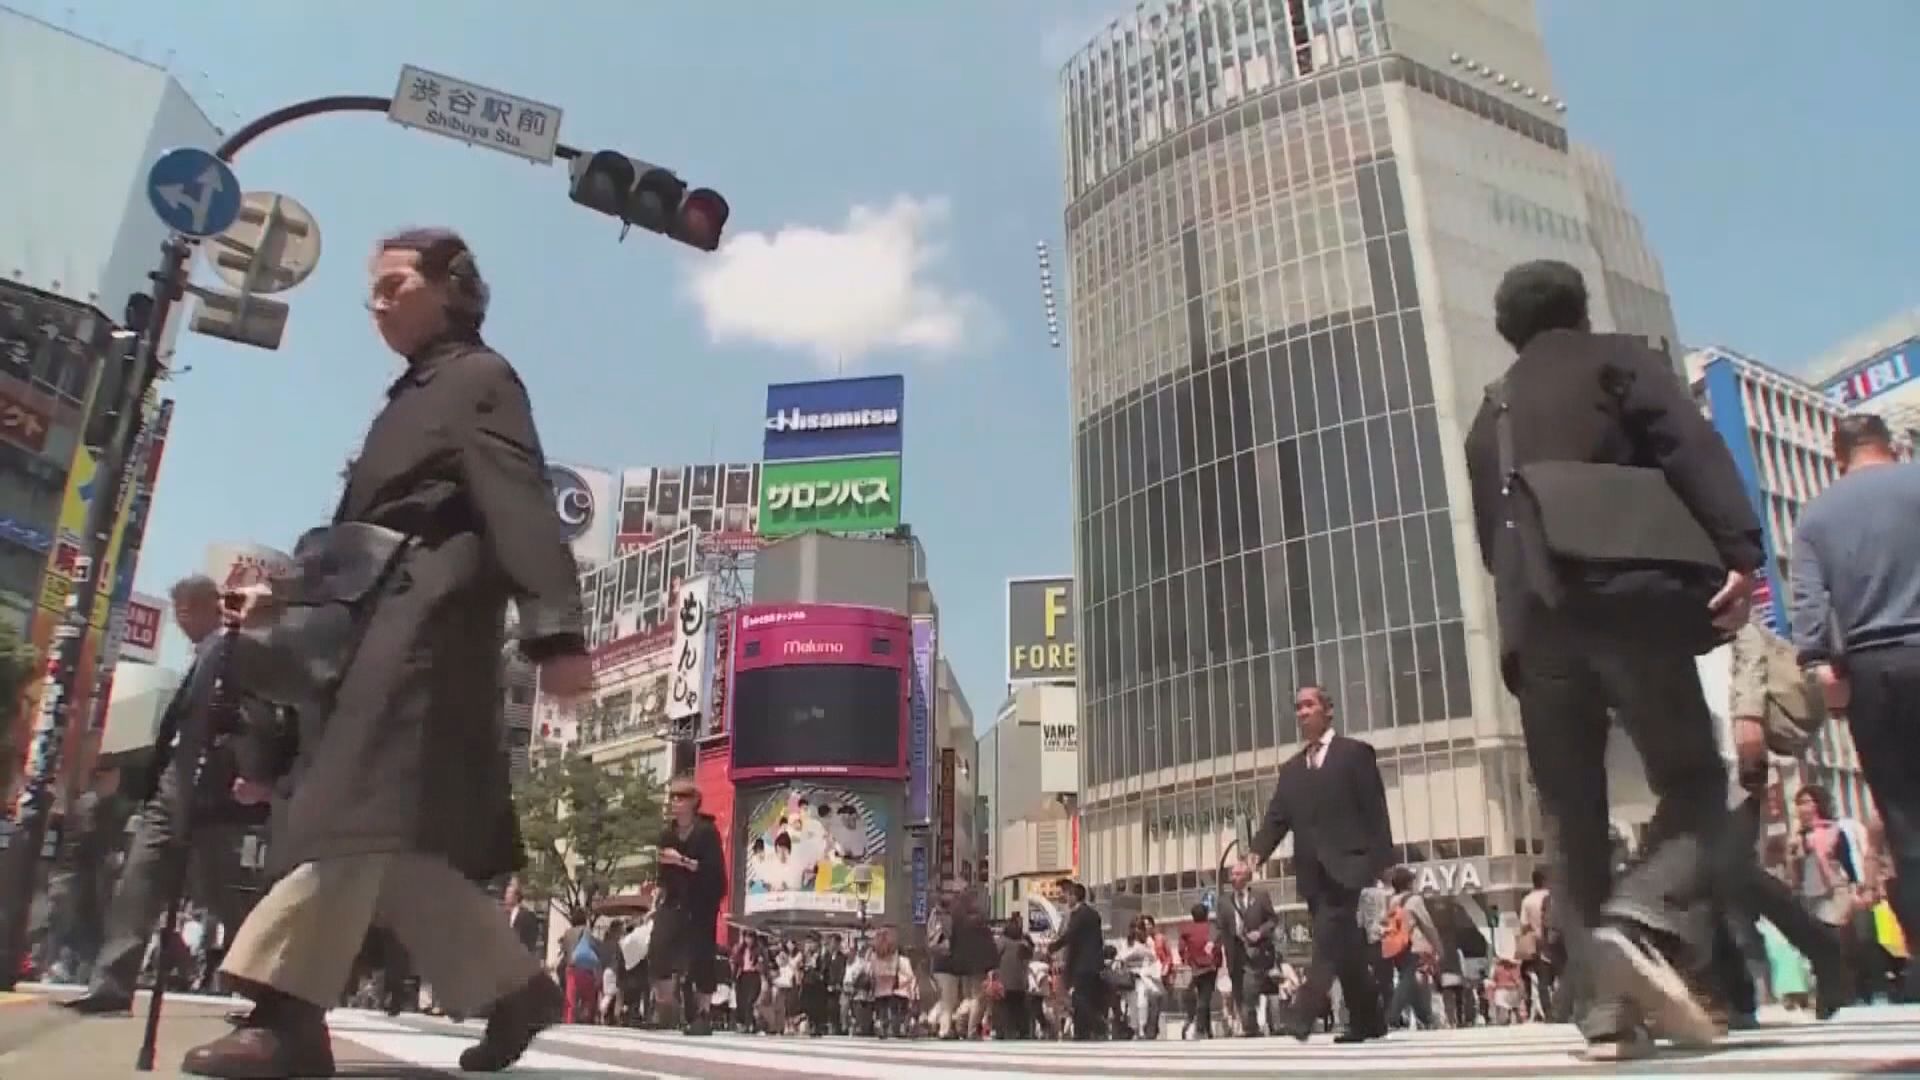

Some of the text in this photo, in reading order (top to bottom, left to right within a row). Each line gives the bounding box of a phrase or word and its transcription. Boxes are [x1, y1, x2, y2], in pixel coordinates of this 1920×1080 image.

[410, 77, 546, 137] 渋谷駅前
[425, 110, 489, 139] Shibuya
[767, 407, 897, 432] Hisamitsu
[768, 477, 891, 511] サロンパス
[1045, 586, 1066, 637] F
[673, 591, 703, 710] もんじゃ
[1408, 862, 1481, 892] AYA
